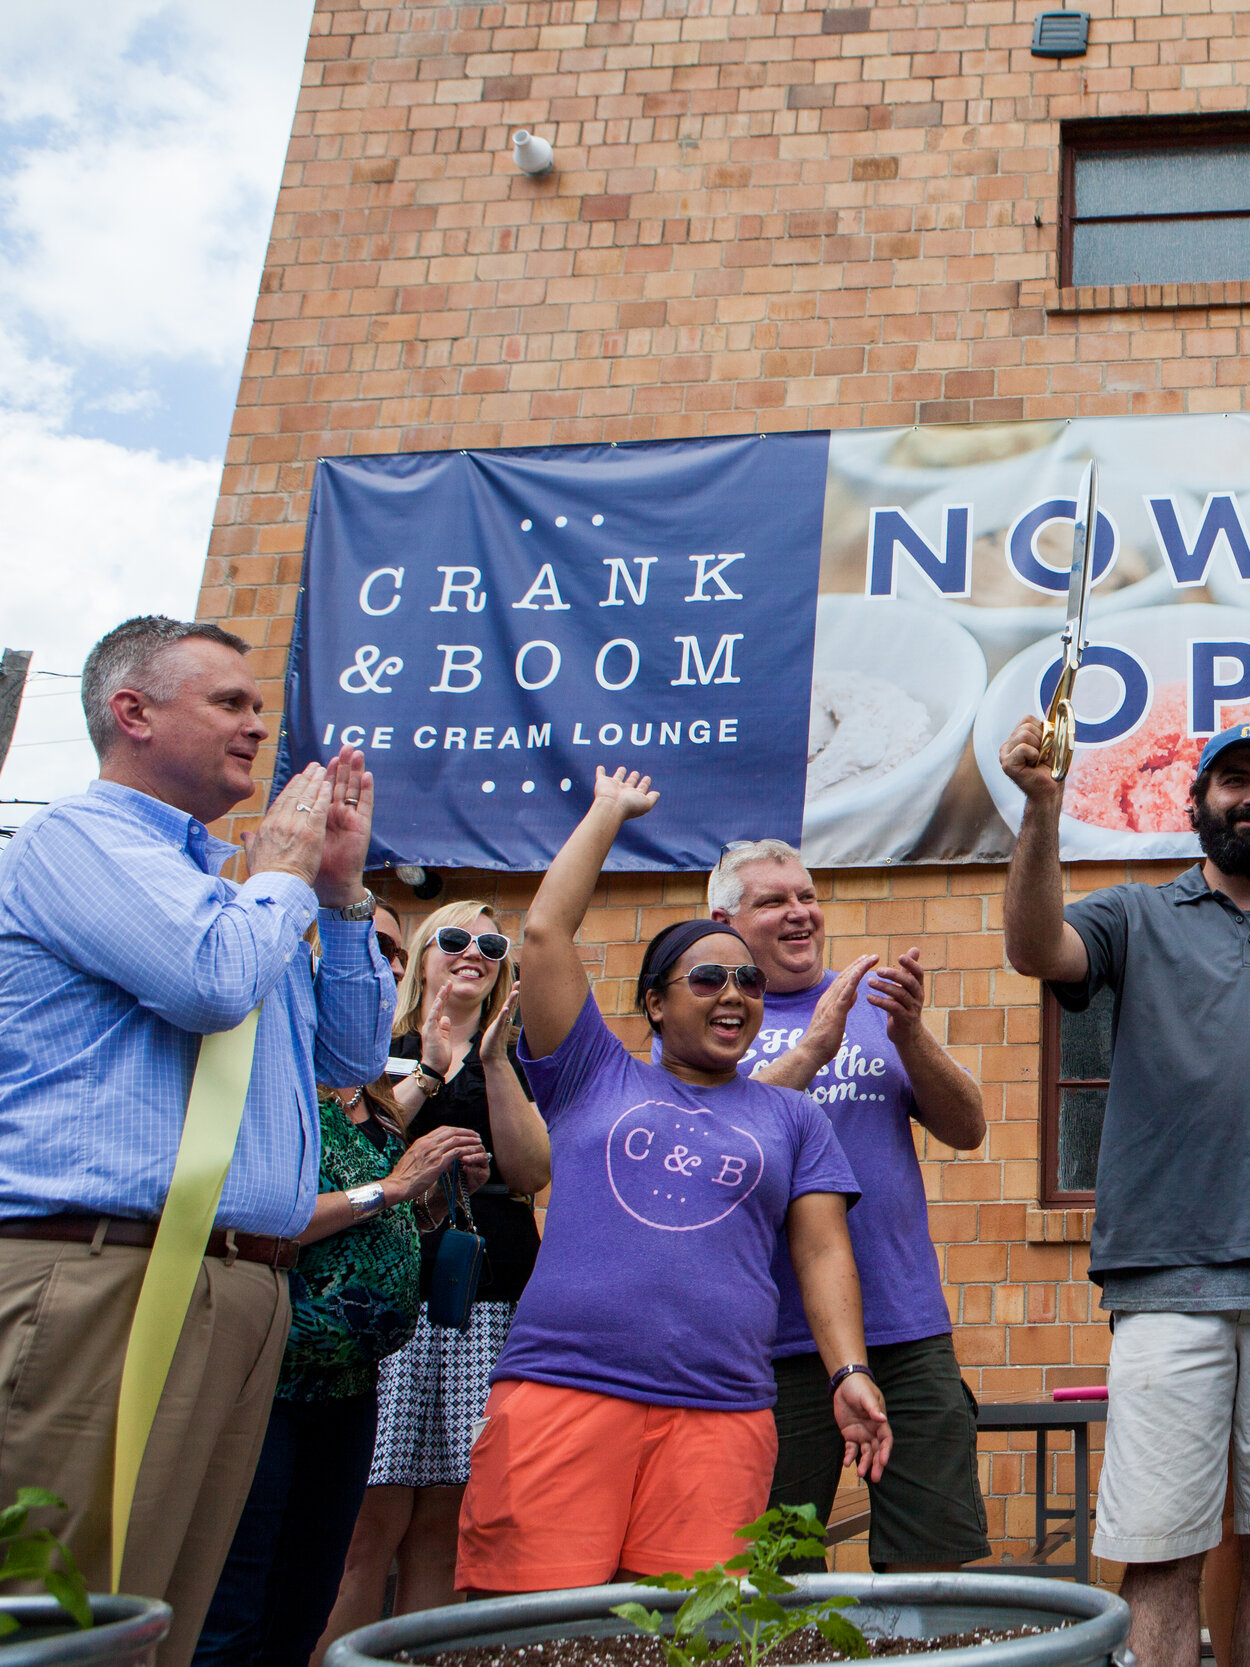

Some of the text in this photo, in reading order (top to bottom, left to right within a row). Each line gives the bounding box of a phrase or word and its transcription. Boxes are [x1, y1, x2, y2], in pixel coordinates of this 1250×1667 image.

[358, 552, 746, 616] CRANK
[322, 718, 739, 750] ICE CREAM LOUNGE
[834, 1044, 886, 1079] the
[624, 1127, 747, 1187] C & B
